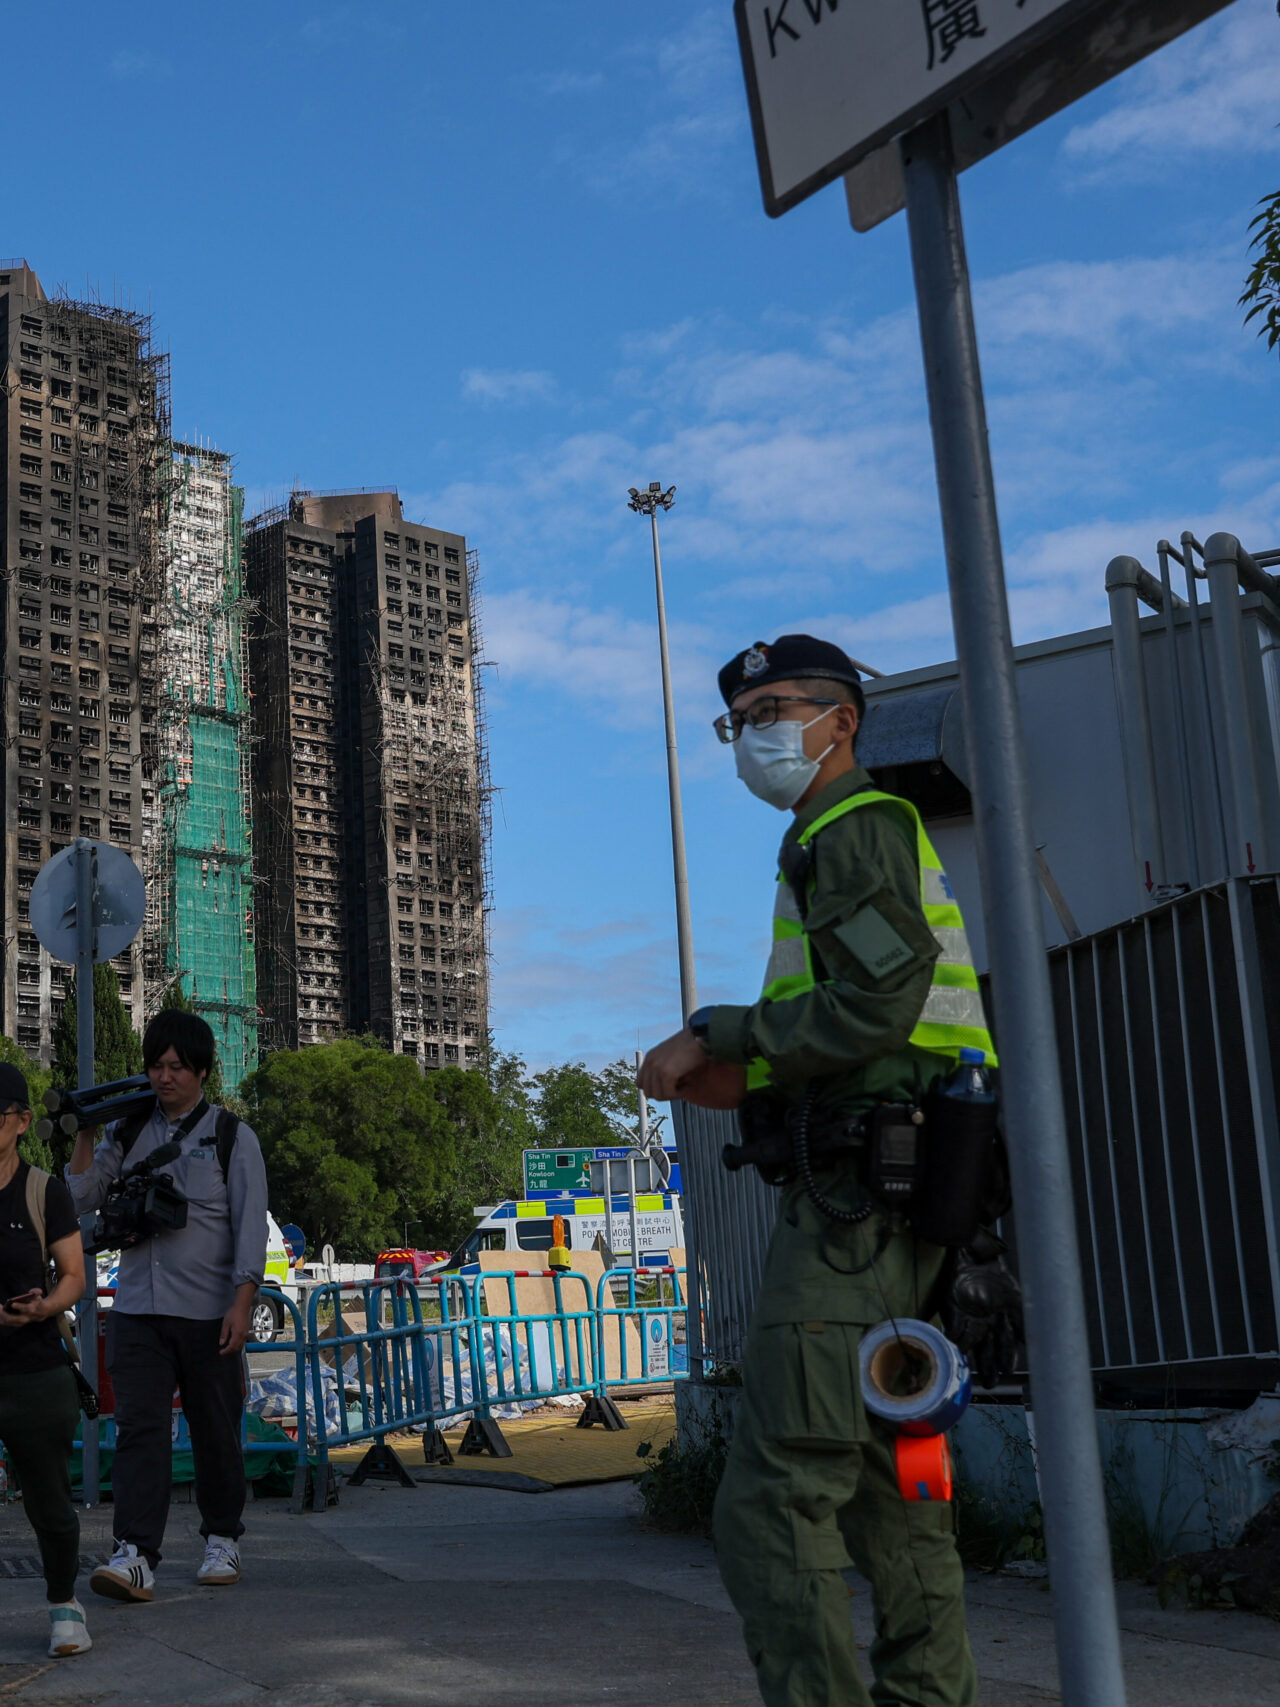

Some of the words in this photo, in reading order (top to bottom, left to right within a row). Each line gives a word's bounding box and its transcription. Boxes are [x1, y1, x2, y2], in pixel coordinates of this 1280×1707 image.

[528, 1162, 546, 1171] 沙田
[641, 1226, 672, 1236] BREATH
[622, 1237, 653, 1247] CETRE
